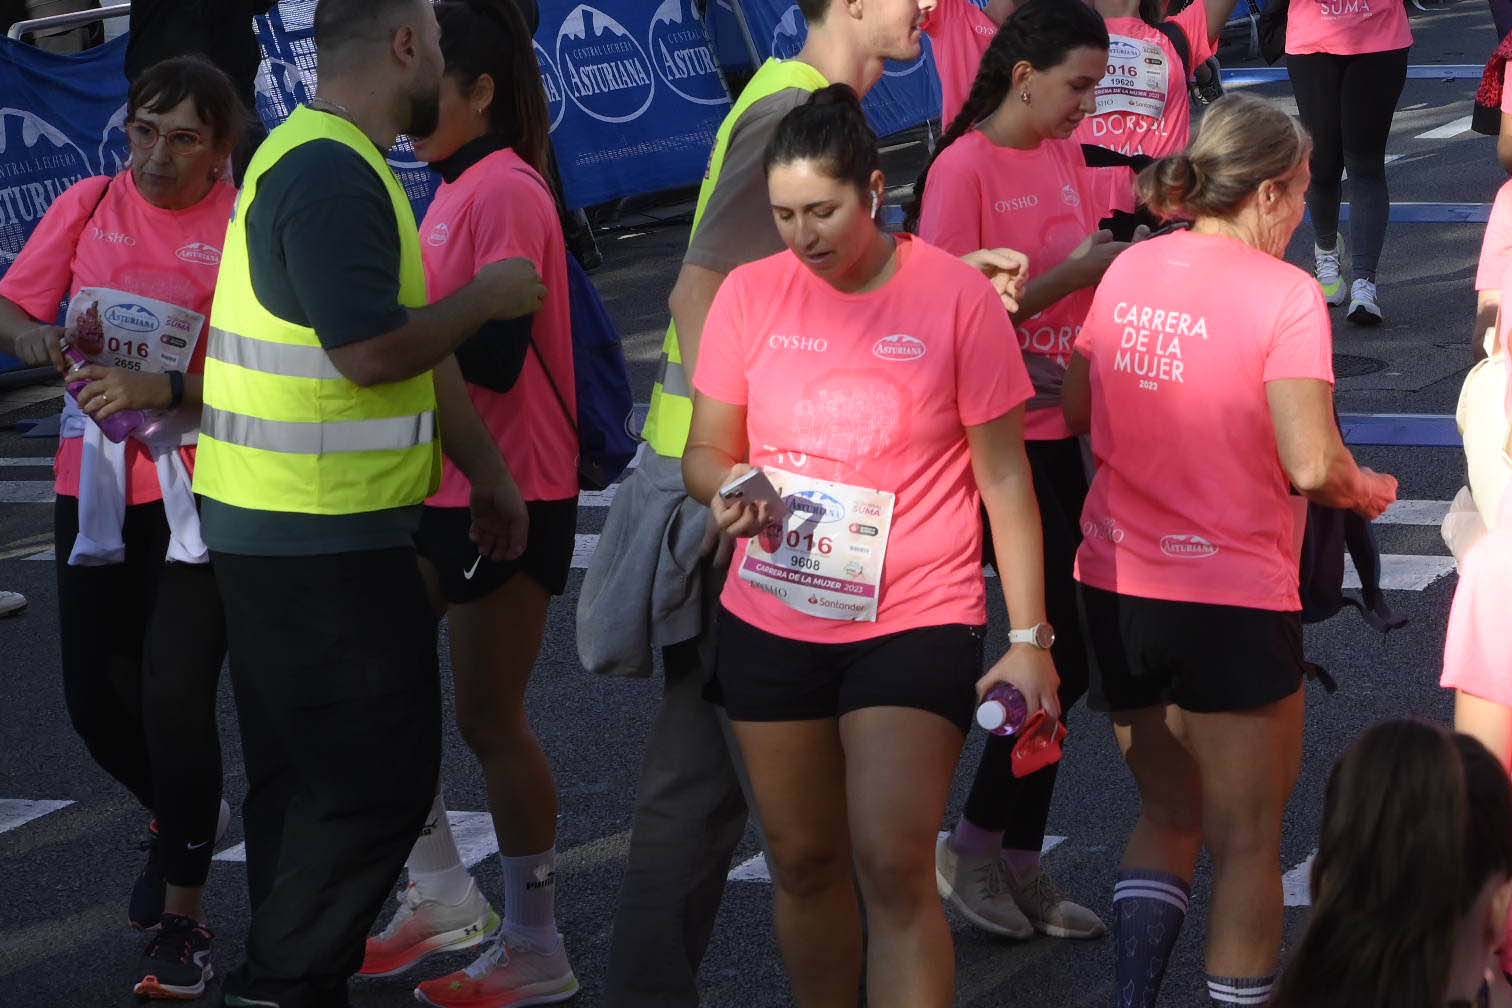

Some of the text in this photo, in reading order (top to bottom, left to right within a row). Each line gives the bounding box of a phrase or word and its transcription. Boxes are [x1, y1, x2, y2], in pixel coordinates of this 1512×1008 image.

[1321, 0, 1370, 15] SUMA
[569, 52, 650, 98] ASTURIANA
[1106, 64, 1138, 76] 016
[1111, 78, 1135, 87] 19620
[1093, 115, 1168, 137] DORSAL
[995, 194, 1039, 213] OYSHO
[108, 309, 154, 330] ASTURIANA
[1112, 301, 1208, 340] CARRERA
[107, 337, 149, 358] 016
[769, 335, 925, 357] OYSHO ASTURIANA
[1121, 327, 1182, 359] DE LA
[114, 357, 141, 372] 2655
[1113, 350, 1185, 384] MUJER
[852, 503, 881, 517] SUMA
[786, 530, 833, 555] 016
[1162, 540, 1216, 556] ASTURIANA
[791, 555, 820, 571] 9608
[755, 562, 864, 594] CARRERA DE LA MUJER 2023
[819, 597, 866, 612] Santander
